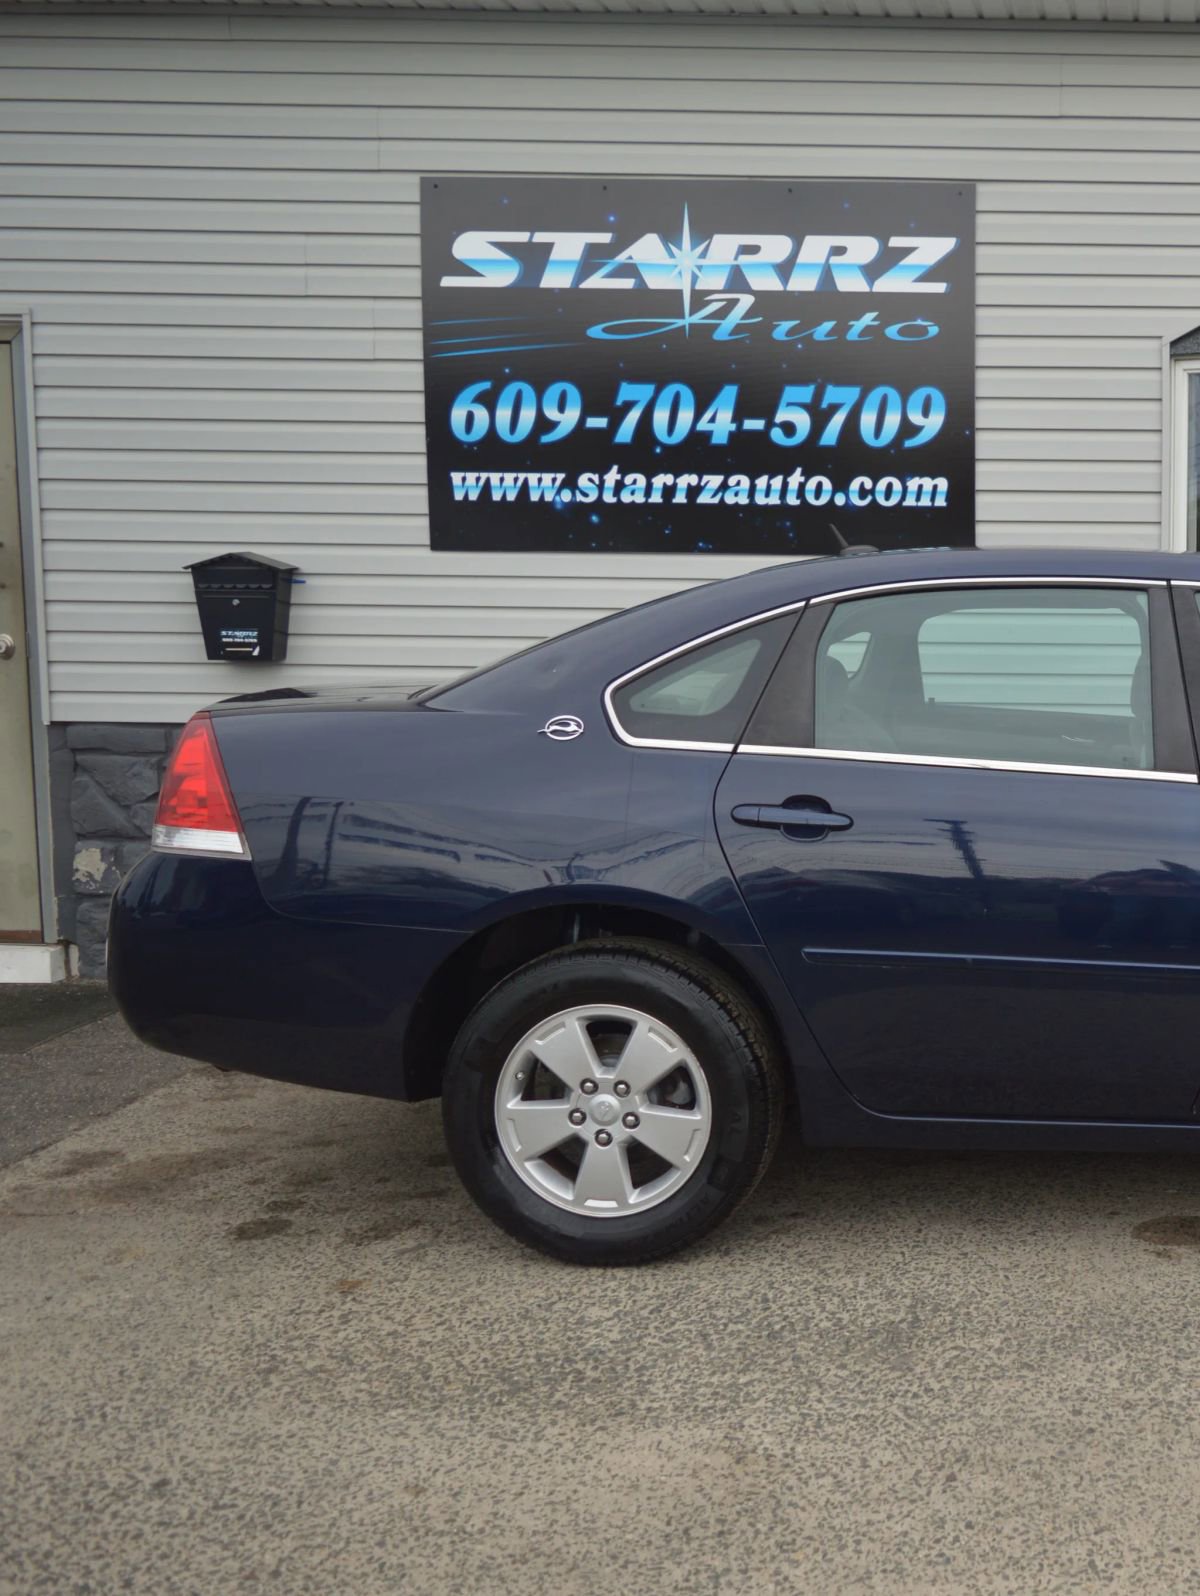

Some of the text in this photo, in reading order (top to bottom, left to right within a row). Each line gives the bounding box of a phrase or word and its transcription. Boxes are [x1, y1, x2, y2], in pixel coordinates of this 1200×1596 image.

[439, 230, 960, 293] STARRZ
[586, 293, 940, 341] Auto
[449, 380, 948, 448] 609-704-5709
[449, 464, 949, 508] www.starrzauto.com
